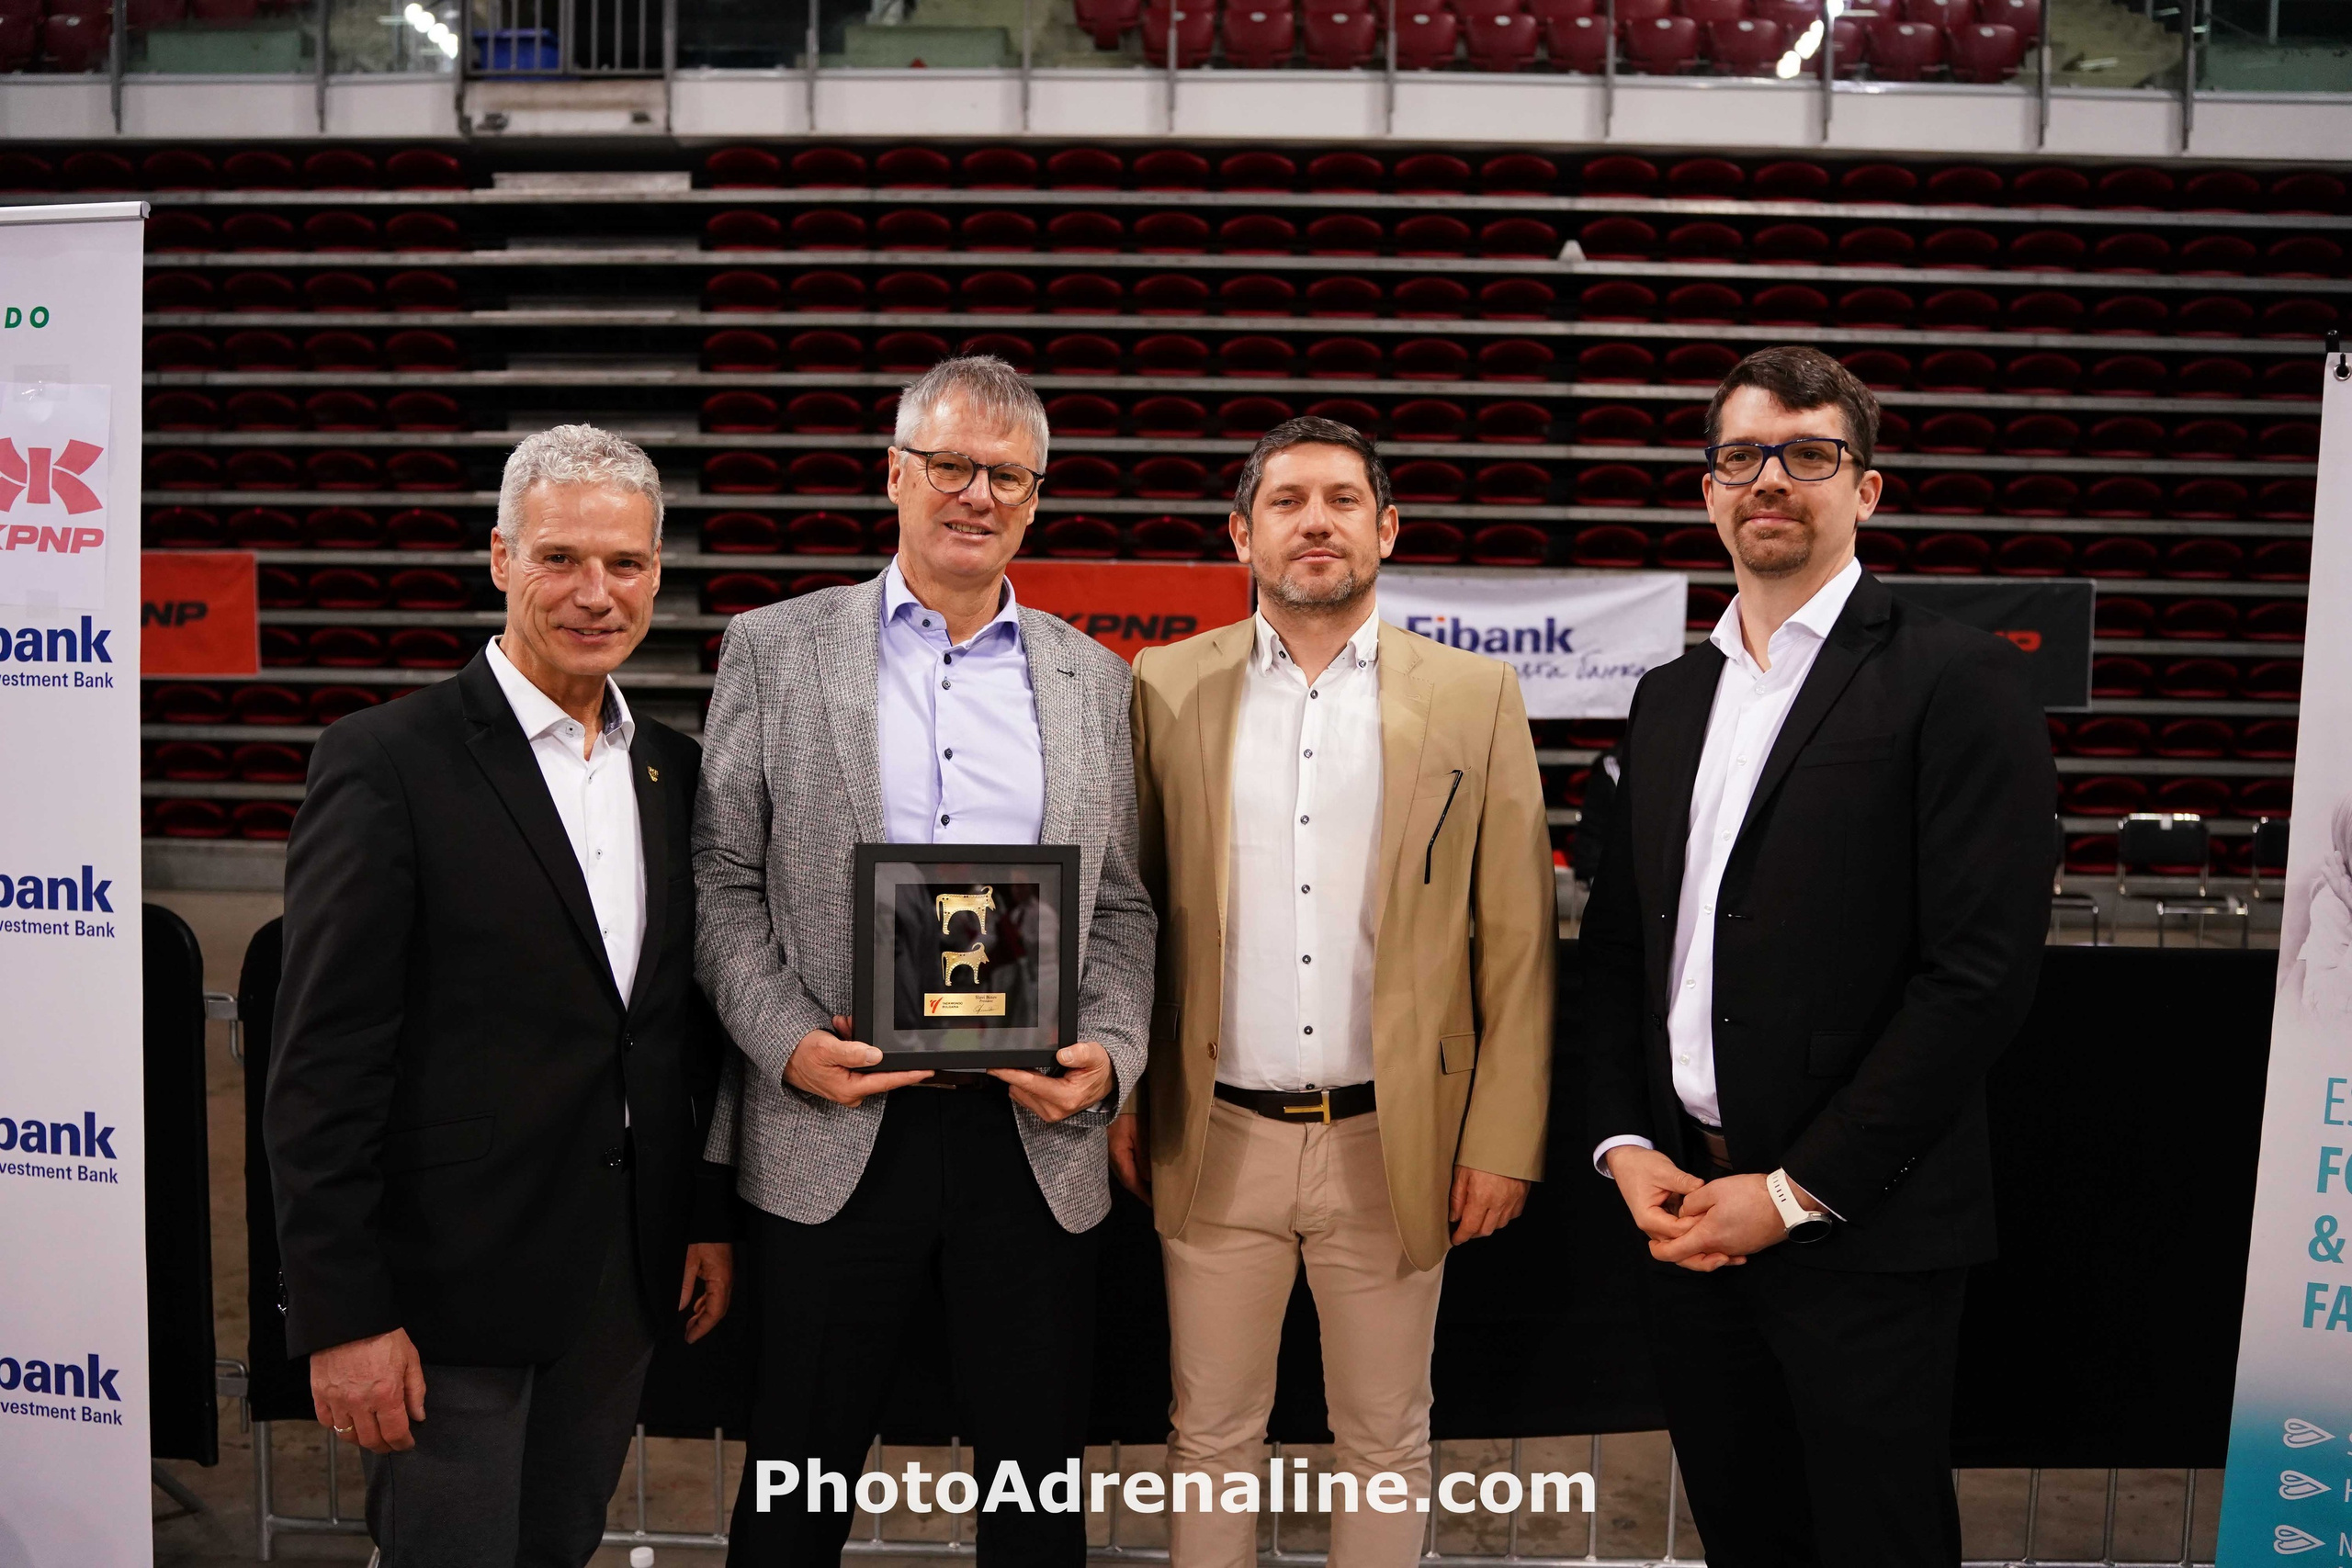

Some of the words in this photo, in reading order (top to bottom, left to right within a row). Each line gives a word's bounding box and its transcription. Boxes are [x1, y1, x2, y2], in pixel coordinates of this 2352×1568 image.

[0, 672, 69, 687] estment
[74, 671, 114, 688] Bank
[74, 919, 115, 938] Bank
[2324, 1077, 2352, 1125] E
[77, 1165, 119, 1184] Bank
[2316, 1145, 2352, 1194] F
[2308, 1214, 2346, 1264] &
[81, 1405, 122, 1426] Bank
